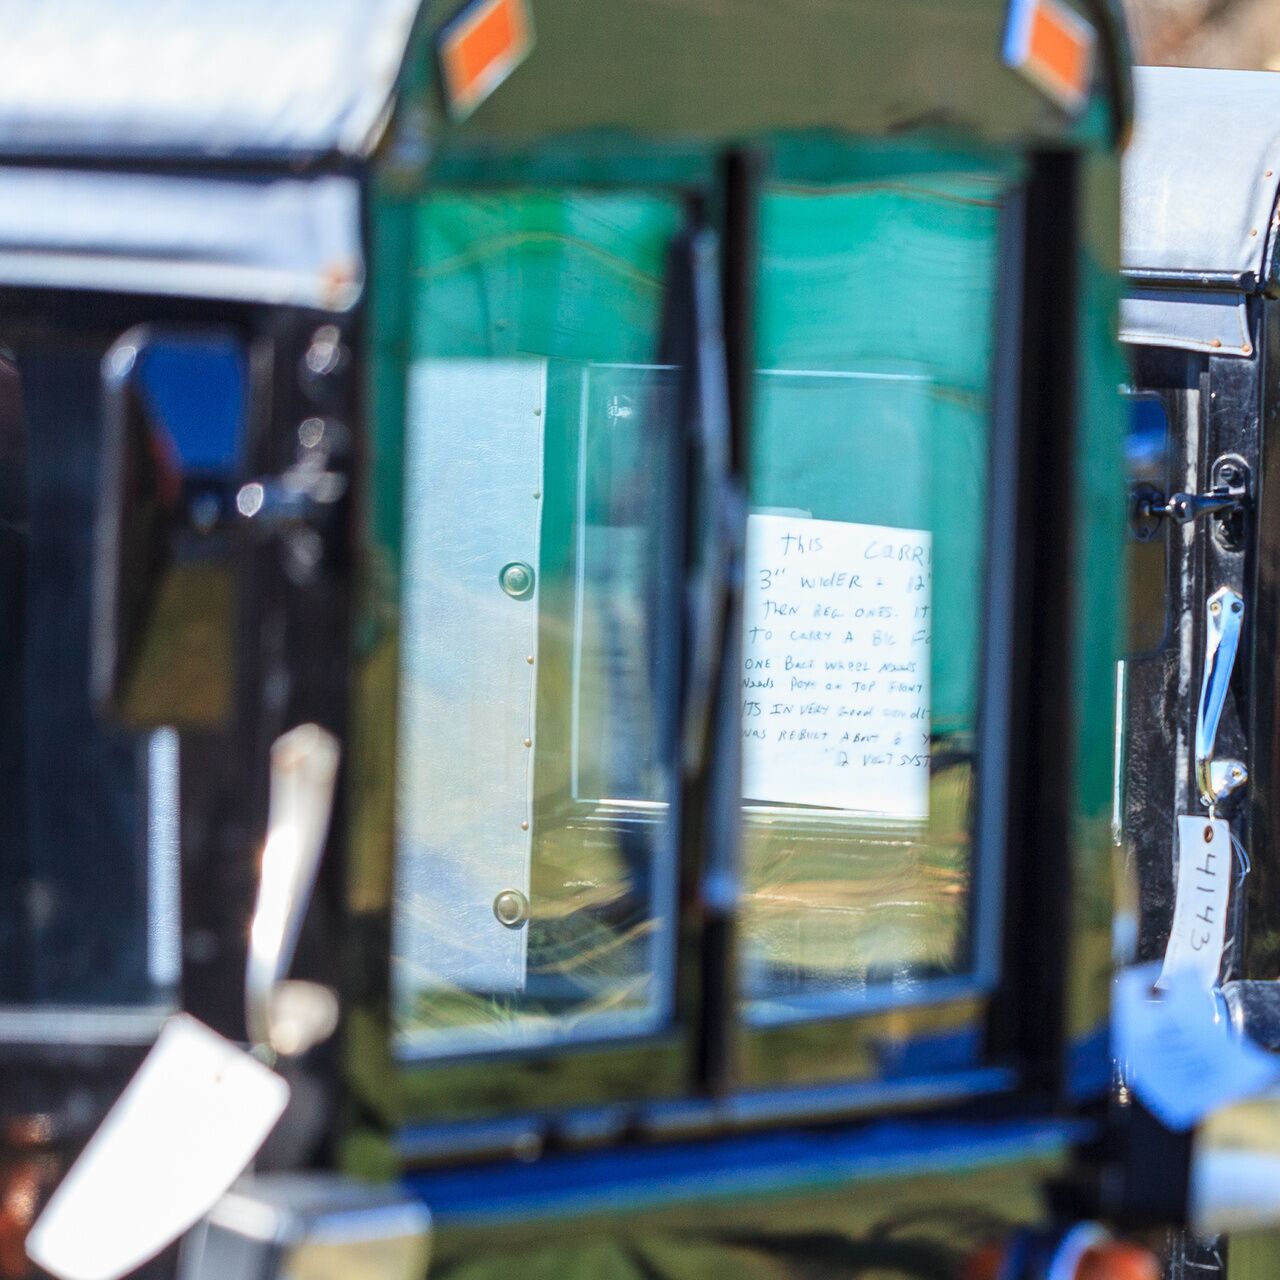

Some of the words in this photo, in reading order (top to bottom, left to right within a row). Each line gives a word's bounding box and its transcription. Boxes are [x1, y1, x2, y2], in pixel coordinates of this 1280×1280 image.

[844, 631, 854, 643] A
[744, 658, 771, 670] ONE
[1190, 853, 1217, 952] 4143
